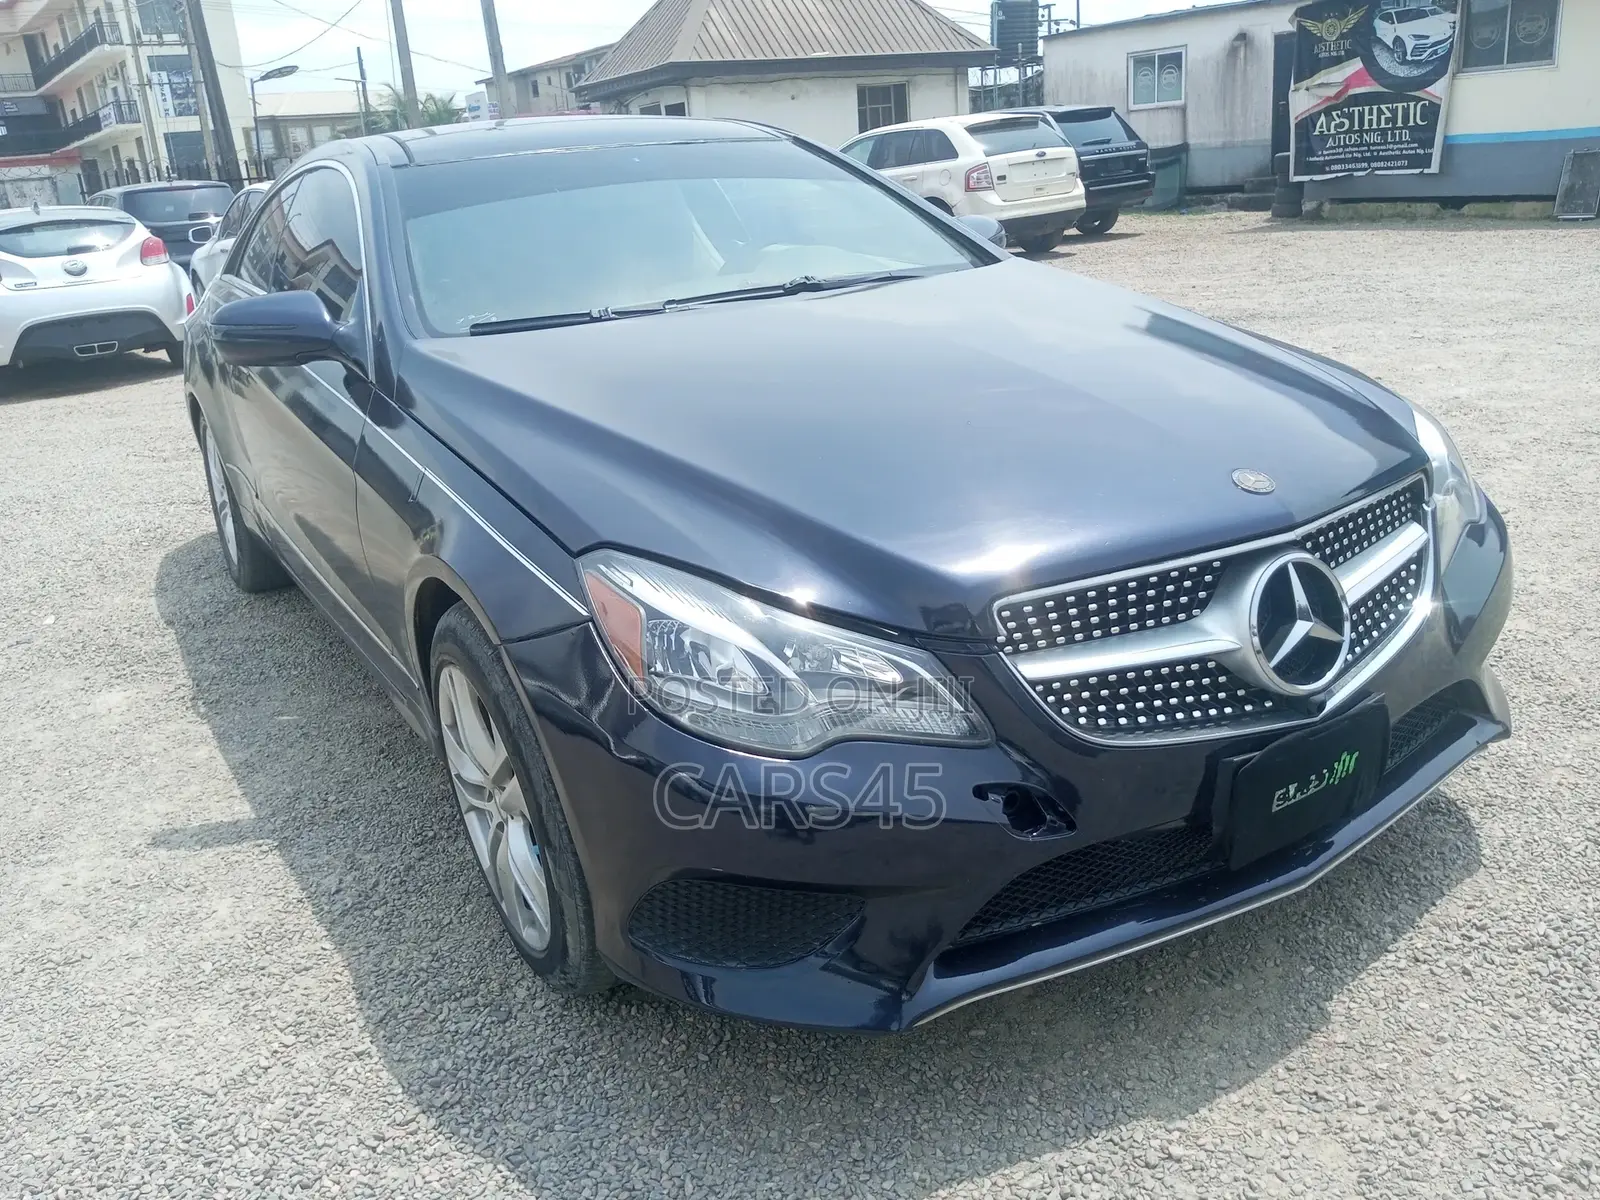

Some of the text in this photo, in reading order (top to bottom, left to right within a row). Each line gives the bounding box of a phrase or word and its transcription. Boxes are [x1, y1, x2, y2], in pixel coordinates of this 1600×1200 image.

[1312, 100, 1429, 136] AESTHETIC
[1325, 130, 1411, 148] AUTOS NIG. LTD.
